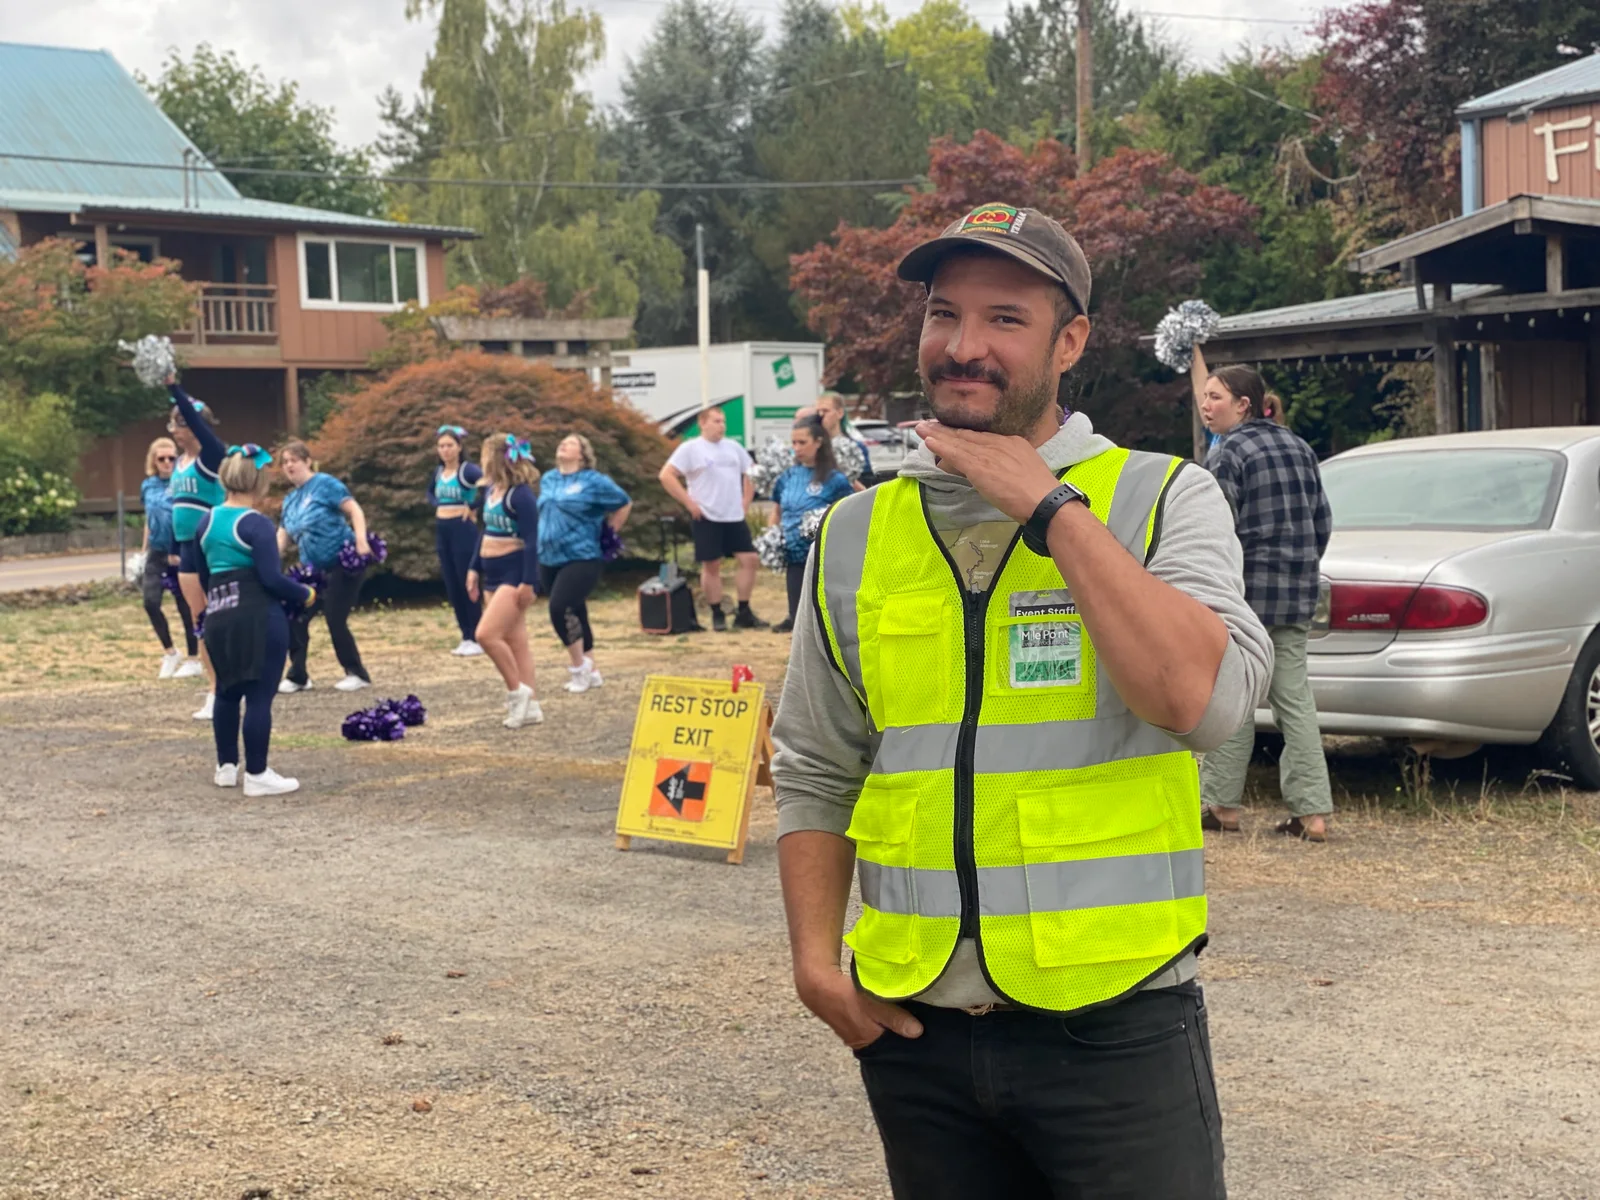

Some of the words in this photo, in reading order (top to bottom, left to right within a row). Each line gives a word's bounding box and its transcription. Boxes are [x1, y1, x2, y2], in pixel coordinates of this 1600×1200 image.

[1533, 115, 1600, 182] F
[611, 375, 655, 386] nterprise
[1016, 609, 1045, 617] Event
[1048, 606, 1075, 616] Staff
[651, 694, 697, 714] REST
[700, 698, 748, 718] STOP
[674, 726, 713, 747] EXIT
